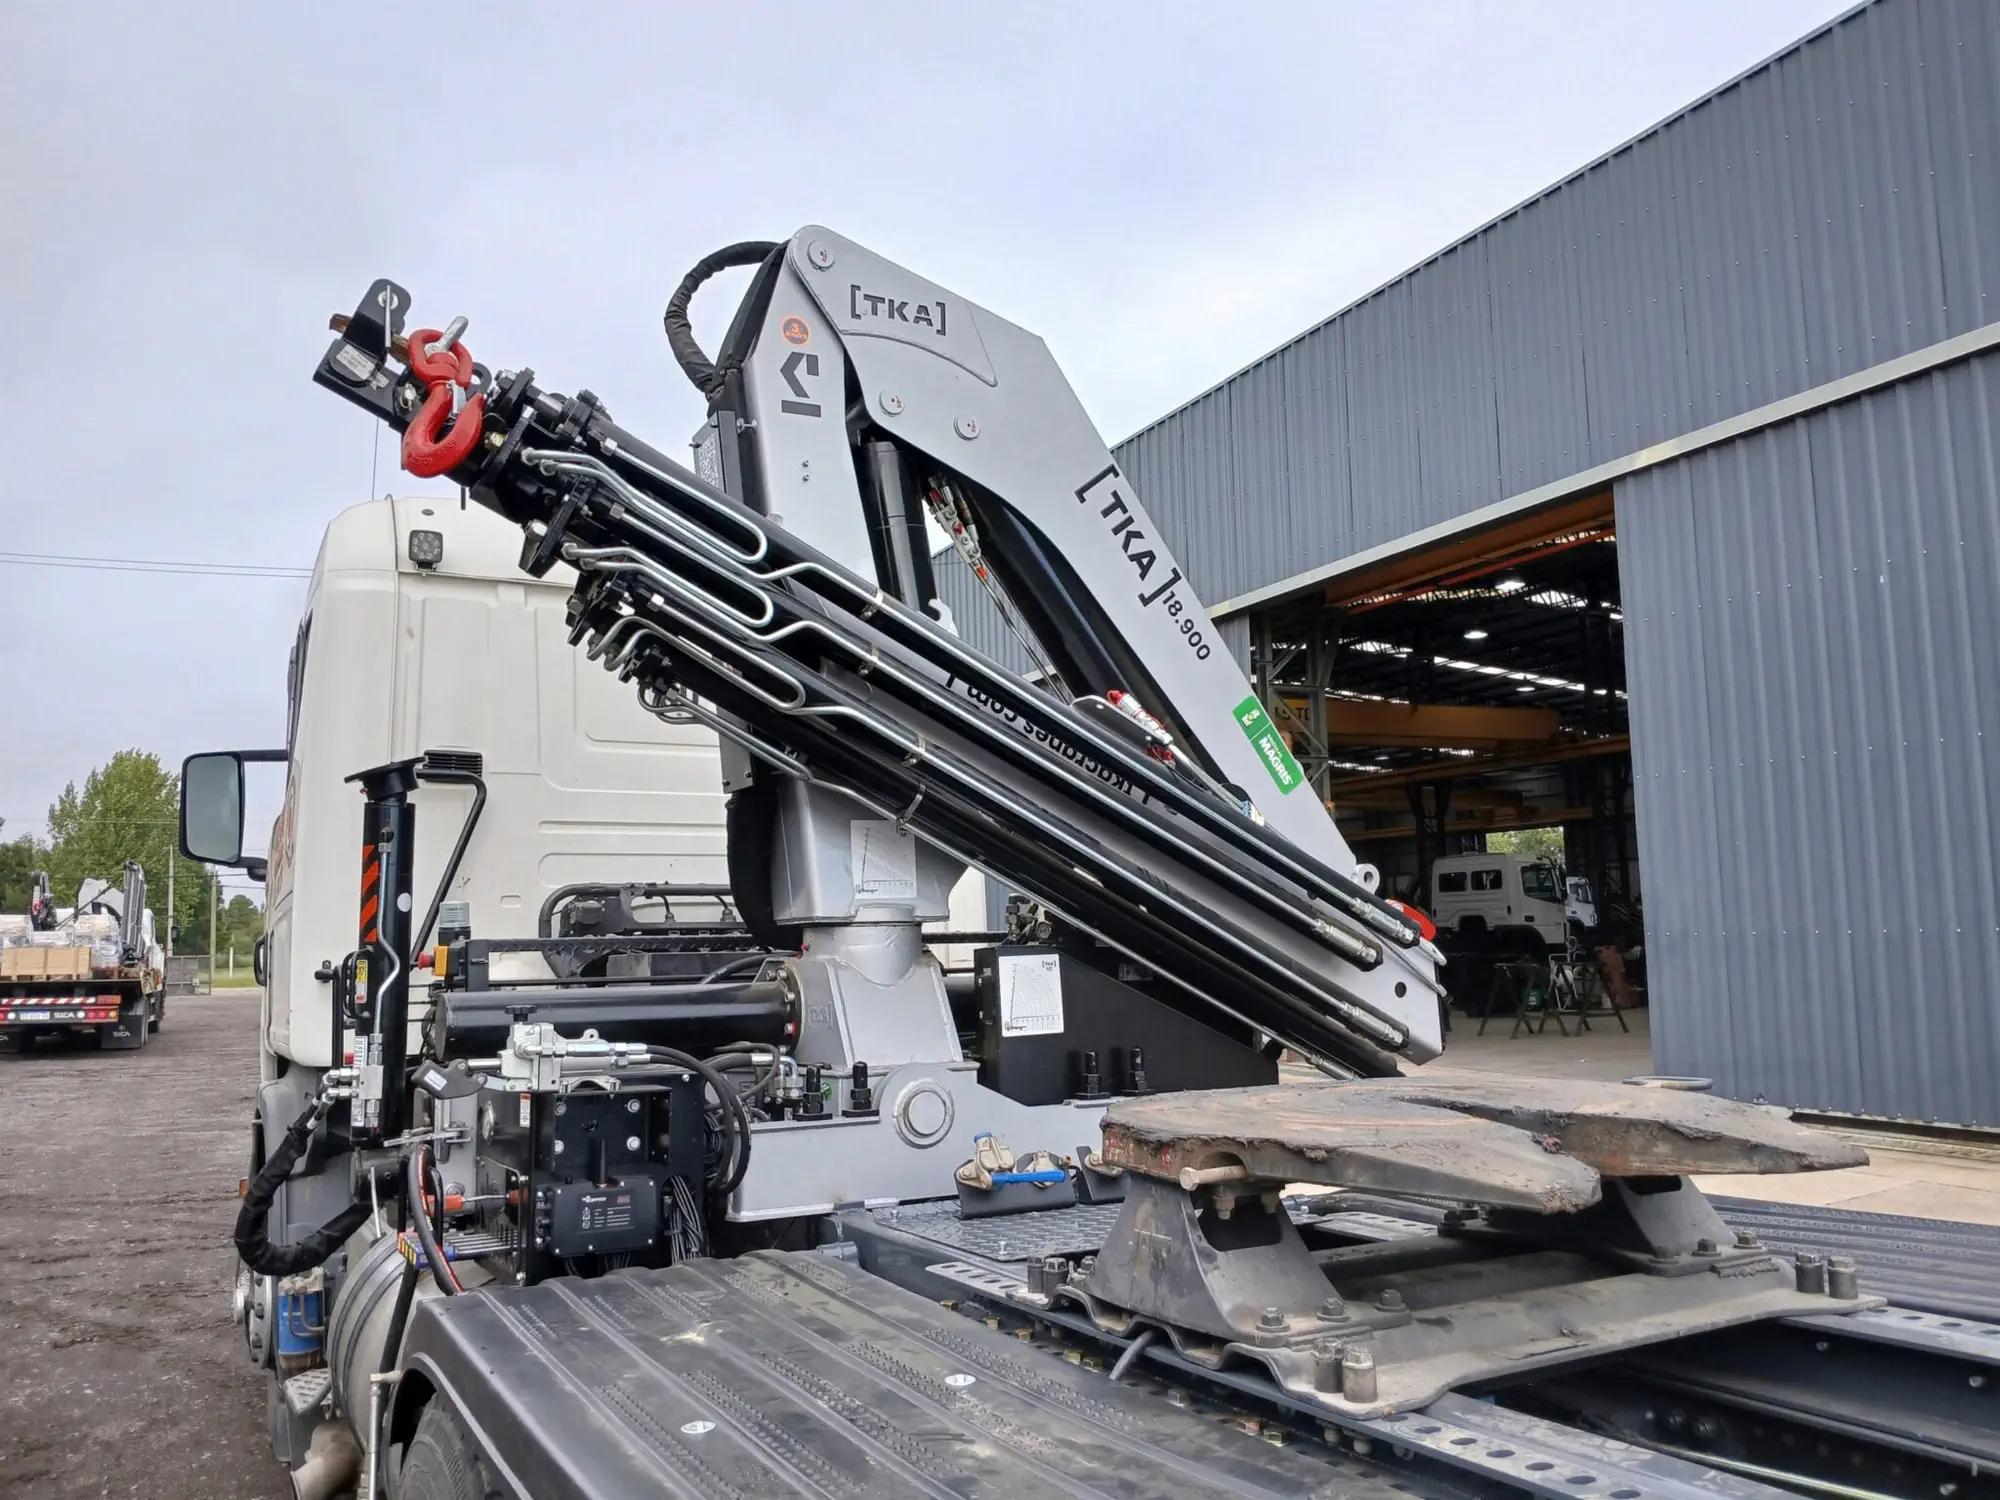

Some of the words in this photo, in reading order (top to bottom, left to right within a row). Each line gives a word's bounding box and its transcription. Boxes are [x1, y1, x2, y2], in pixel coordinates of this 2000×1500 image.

[850, 284, 946, 336] [TKA]
[1074, 463, 1182, 608] [TKA]
[1162, 590, 1211, 661] 18.900
[966, 683, 1134, 797] tkacranescom
[1258, 736, 1293, 785] MAGRIS
